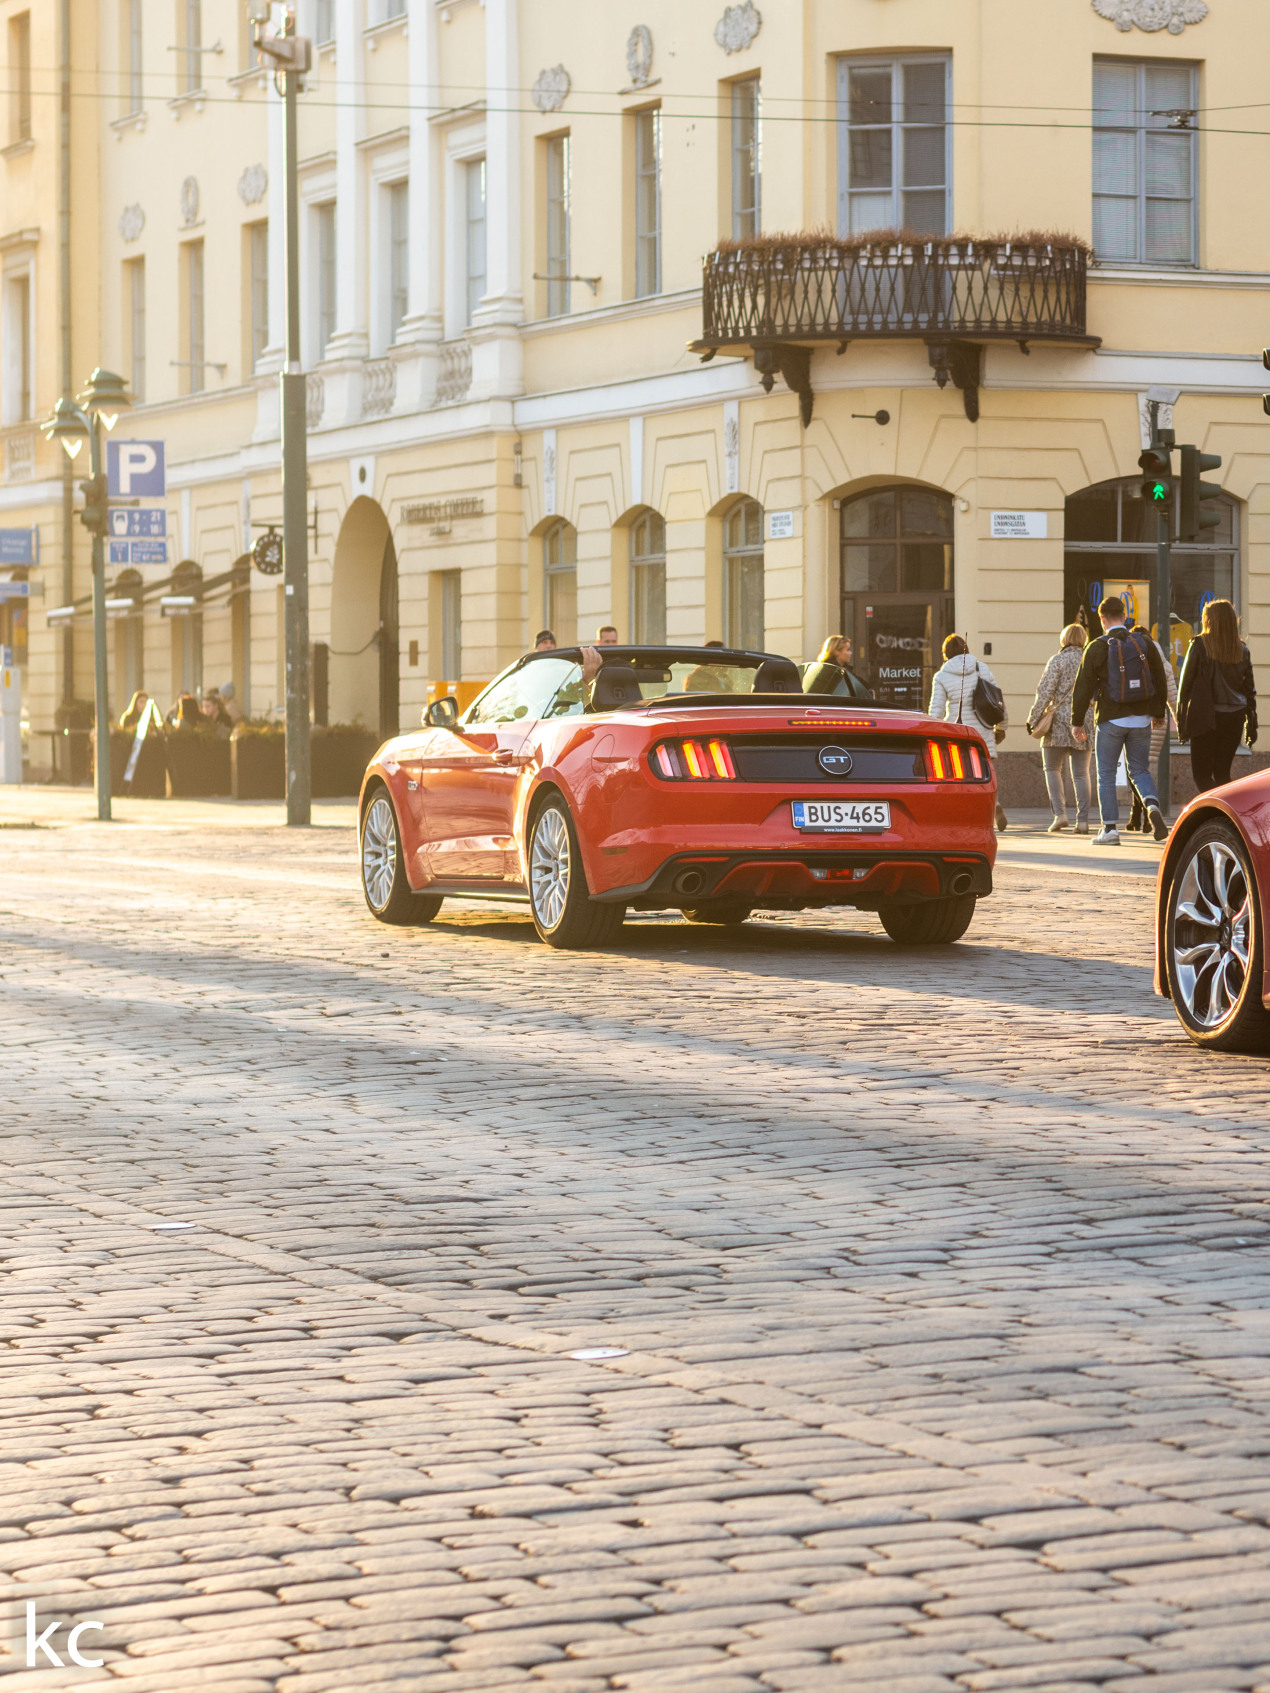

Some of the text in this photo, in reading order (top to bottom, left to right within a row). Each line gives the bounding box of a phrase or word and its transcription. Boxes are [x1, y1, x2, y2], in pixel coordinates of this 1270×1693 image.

[118, 443, 157, 494] P
[879, 667, 922, 678] Market
[822, 755, 848, 763] GT
